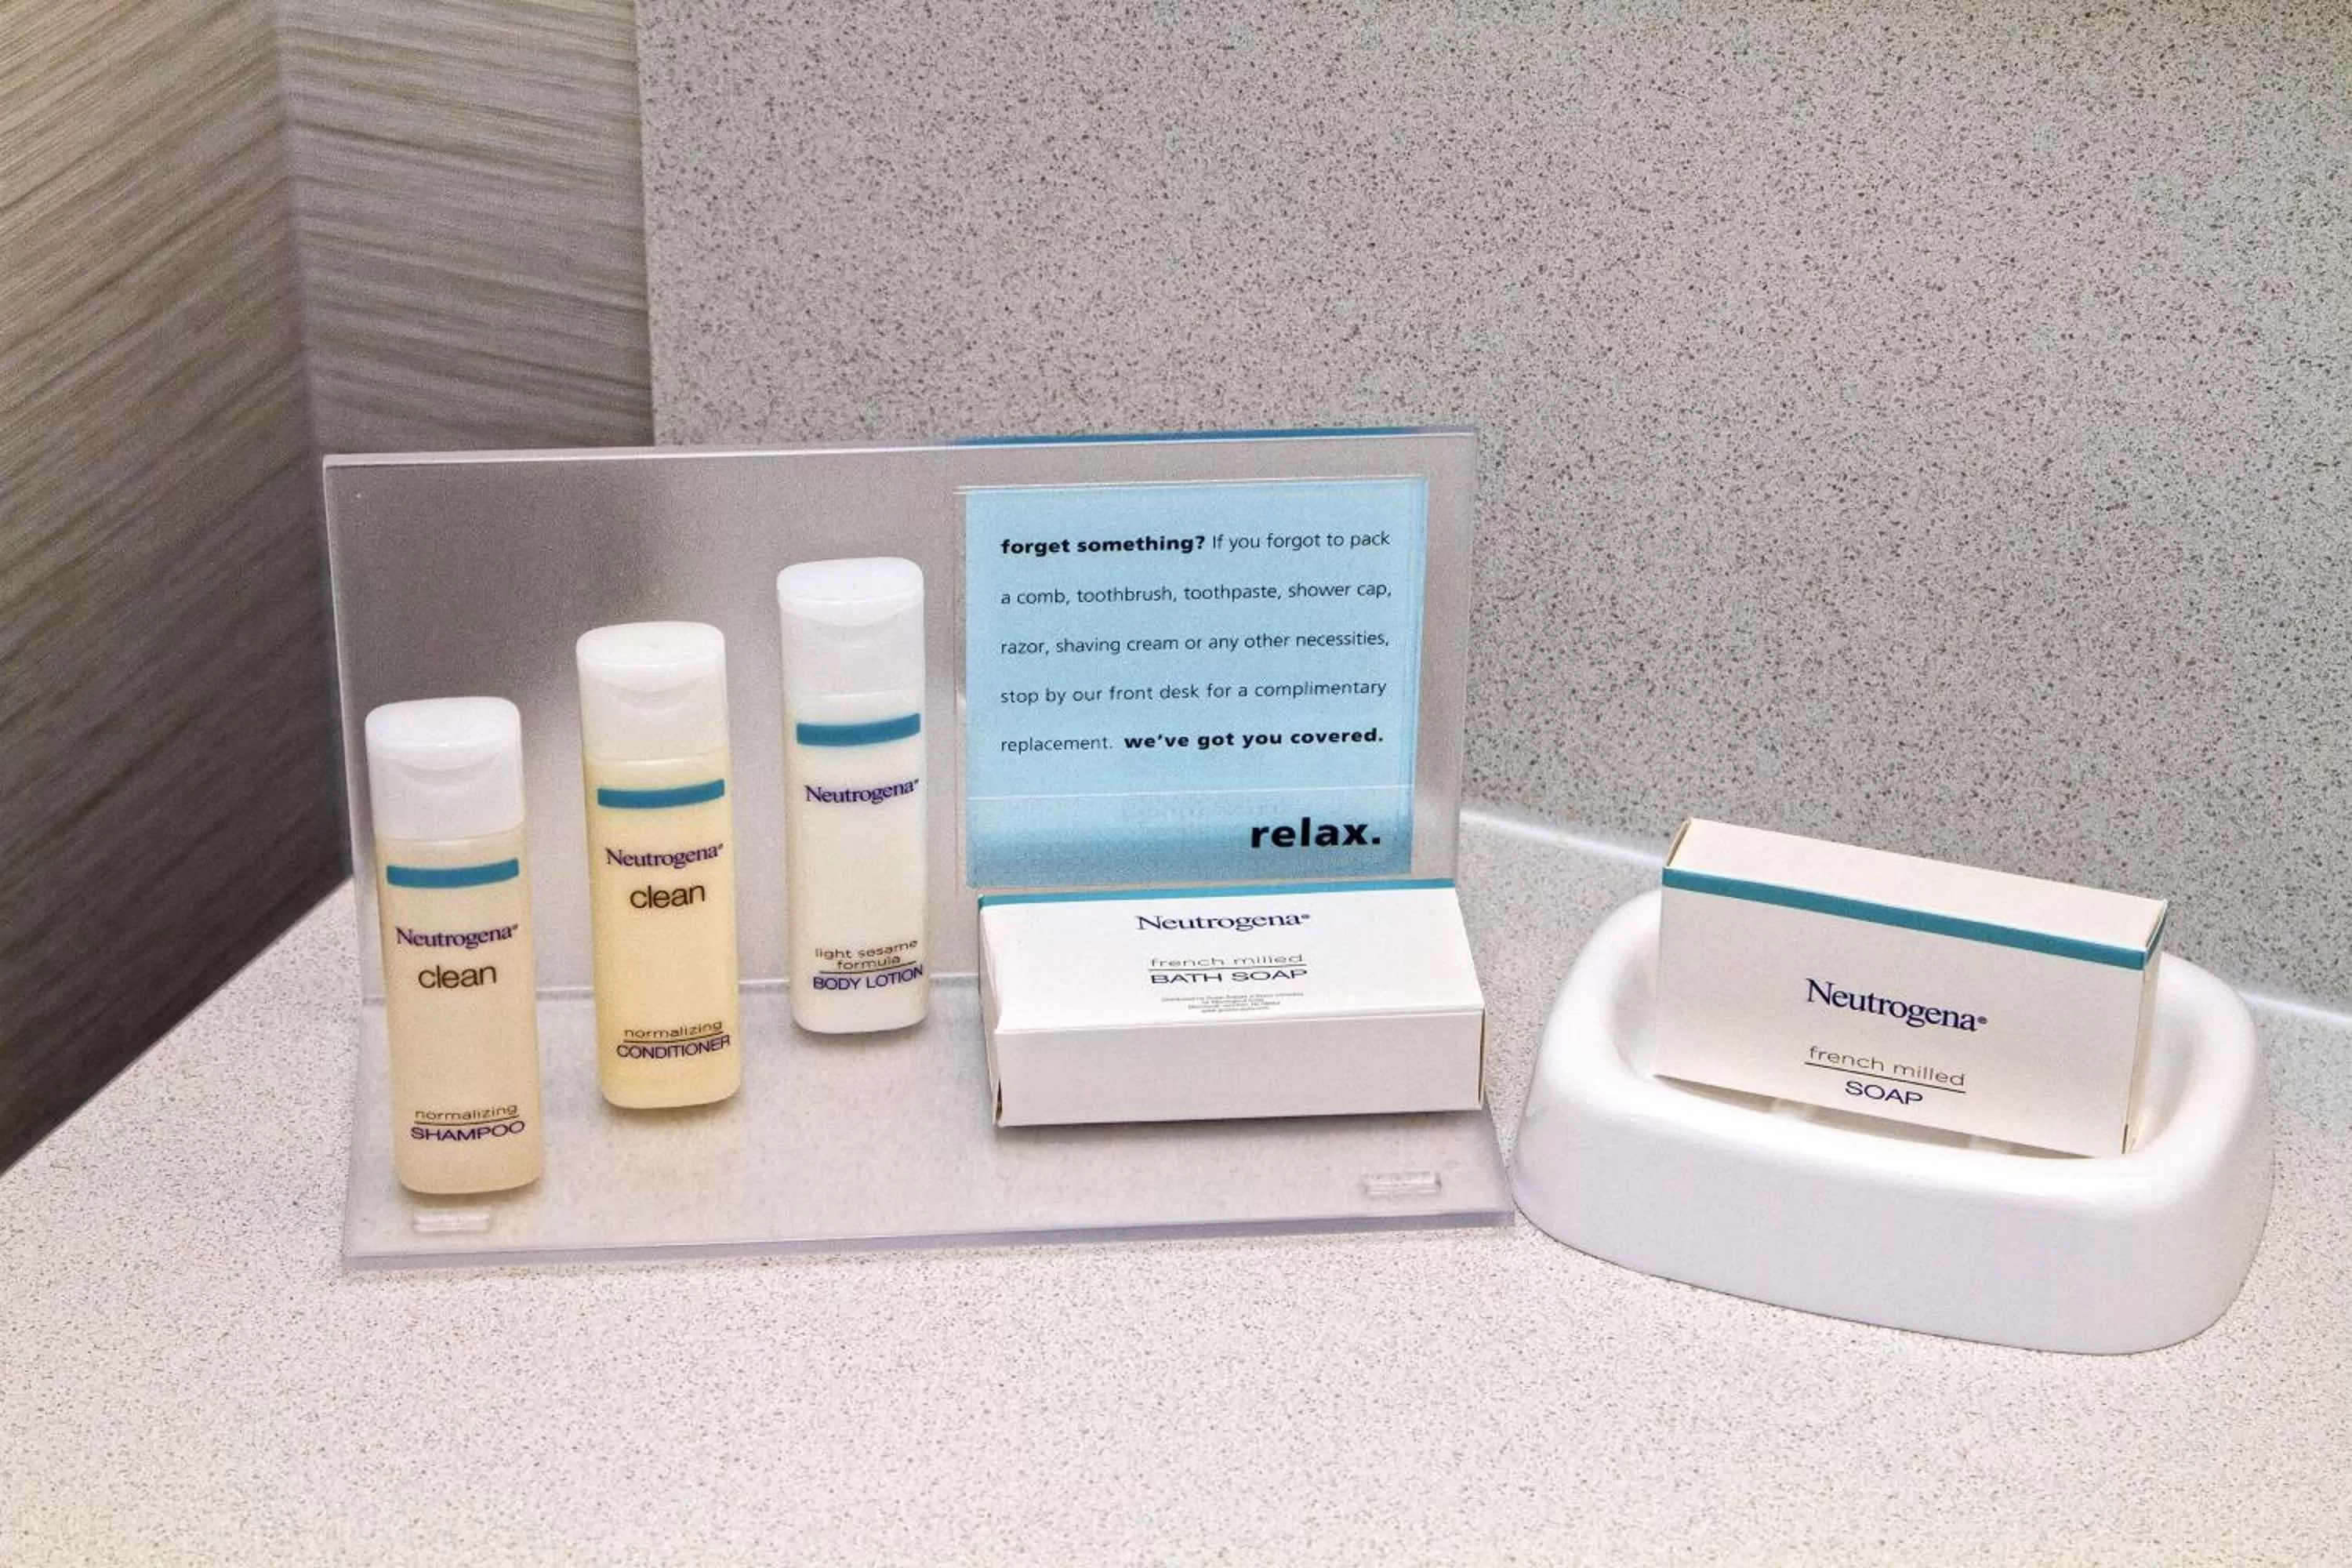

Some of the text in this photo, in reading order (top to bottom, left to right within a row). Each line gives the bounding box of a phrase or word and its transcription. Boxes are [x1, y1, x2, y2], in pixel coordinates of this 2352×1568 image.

[1000, 532, 1390, 557] forget something? If you forgot to pack
[1001, 583, 1392, 605] a comb, toothbrush, toothpaste, shower cap,
[1000, 630, 1389, 656] razor, shaving cream or any other necessities,
[1000, 681, 1386, 706] stop by our front desk for a complimentary
[1000, 736, 1113, 755] replacement.
[1197, 732, 1234, 750] got
[1242, 731, 1283, 748] you
[1290, 728, 1384, 744] covered.
[1250, 818, 1381, 848] relax.
[630, 884, 706, 909] clean
[815, 941, 918, 960] light sesame
[837, 955, 901, 970] formula
[1150, 954, 1303, 967] french milled
[418, 964, 498, 989] clean
[812, 964, 924, 991] BODY LOTION
[1150, 967, 1308, 985] BATH SOAP
[624, 1022, 723, 1039] normalizing
[616, 1034, 731, 1060] CONDITIONER
[1809, 1046, 1965, 1087] french milled
[1845, 1080, 1923, 1105] SOAP
[415, 1105, 518, 1120] normalizing
[411, 1120, 525, 1142] SHAMPOO
